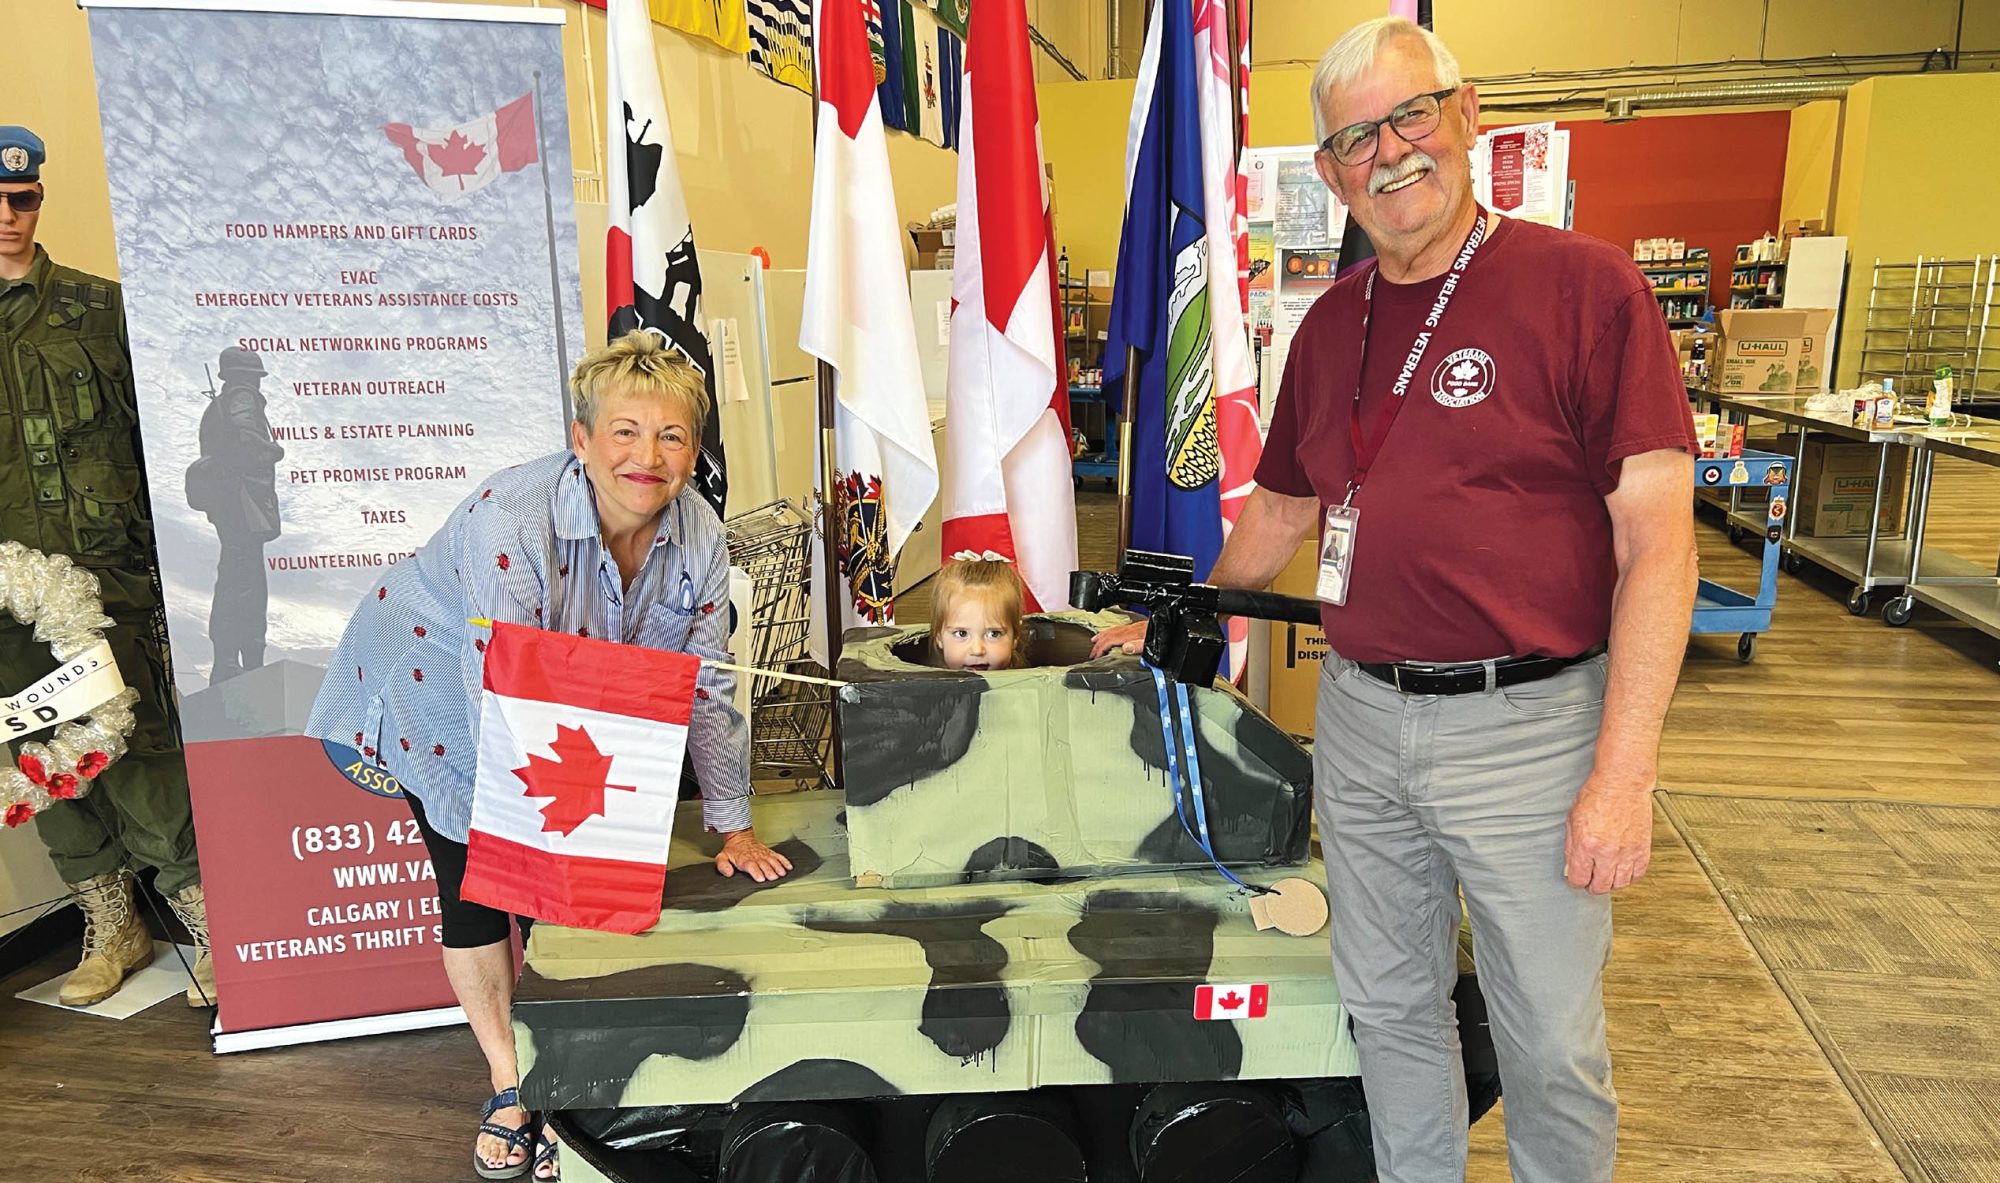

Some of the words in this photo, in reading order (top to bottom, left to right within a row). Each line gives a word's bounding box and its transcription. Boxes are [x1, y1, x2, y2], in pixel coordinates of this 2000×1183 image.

[225, 223, 268, 239] FOOD
[273, 223, 348, 239] HAMPERS
[353, 225, 386, 240] AND
[391, 226, 424, 240] GIFT
[429, 226, 478, 241] CARDS
[1454, 215, 1486, 272] VETERANS
[340, 270, 378, 285] EVAC
[195, 293, 289, 307] EMERGENCY
[294, 293, 373, 307] VETERANS
[378, 293, 468, 307] ASSISTANCE
[473, 293, 518, 306] COSTS
[1425, 273, 1460, 328] HELPING
[239, 338, 295, 352] SOCIAL
[299, 337, 401, 352] NETWORKING
[406, 336, 488, 351] PROGRAMS
[1741, 343, 1785, 351] U-HAUL
[1392, 331, 1432, 397] VETERANS
[292, 382, 362, 396] VETERAN
[366, 380, 446, 395] OUTREACH
[272, 426, 318, 441] WILLS
[324, 425, 336, 440] &
[341, 424, 393, 440] ESTATE
[398, 423, 475, 438] PLANNING
[290, 470, 318, 484] PET
[323, 468, 390, 483] PROMISE
[395, 466, 467, 481] PROGRAM
[361, 510, 407, 525] TAXES
[267, 553, 383, 571] VOLUNTEERING
[5, 658, 98, 711] WOUNDS
[291, 820, 375, 861] (833)
[307, 900, 401, 927] CALGARY
[236, 933, 346, 963] VETERANS
[351, 926, 427, 951] THRIFT
